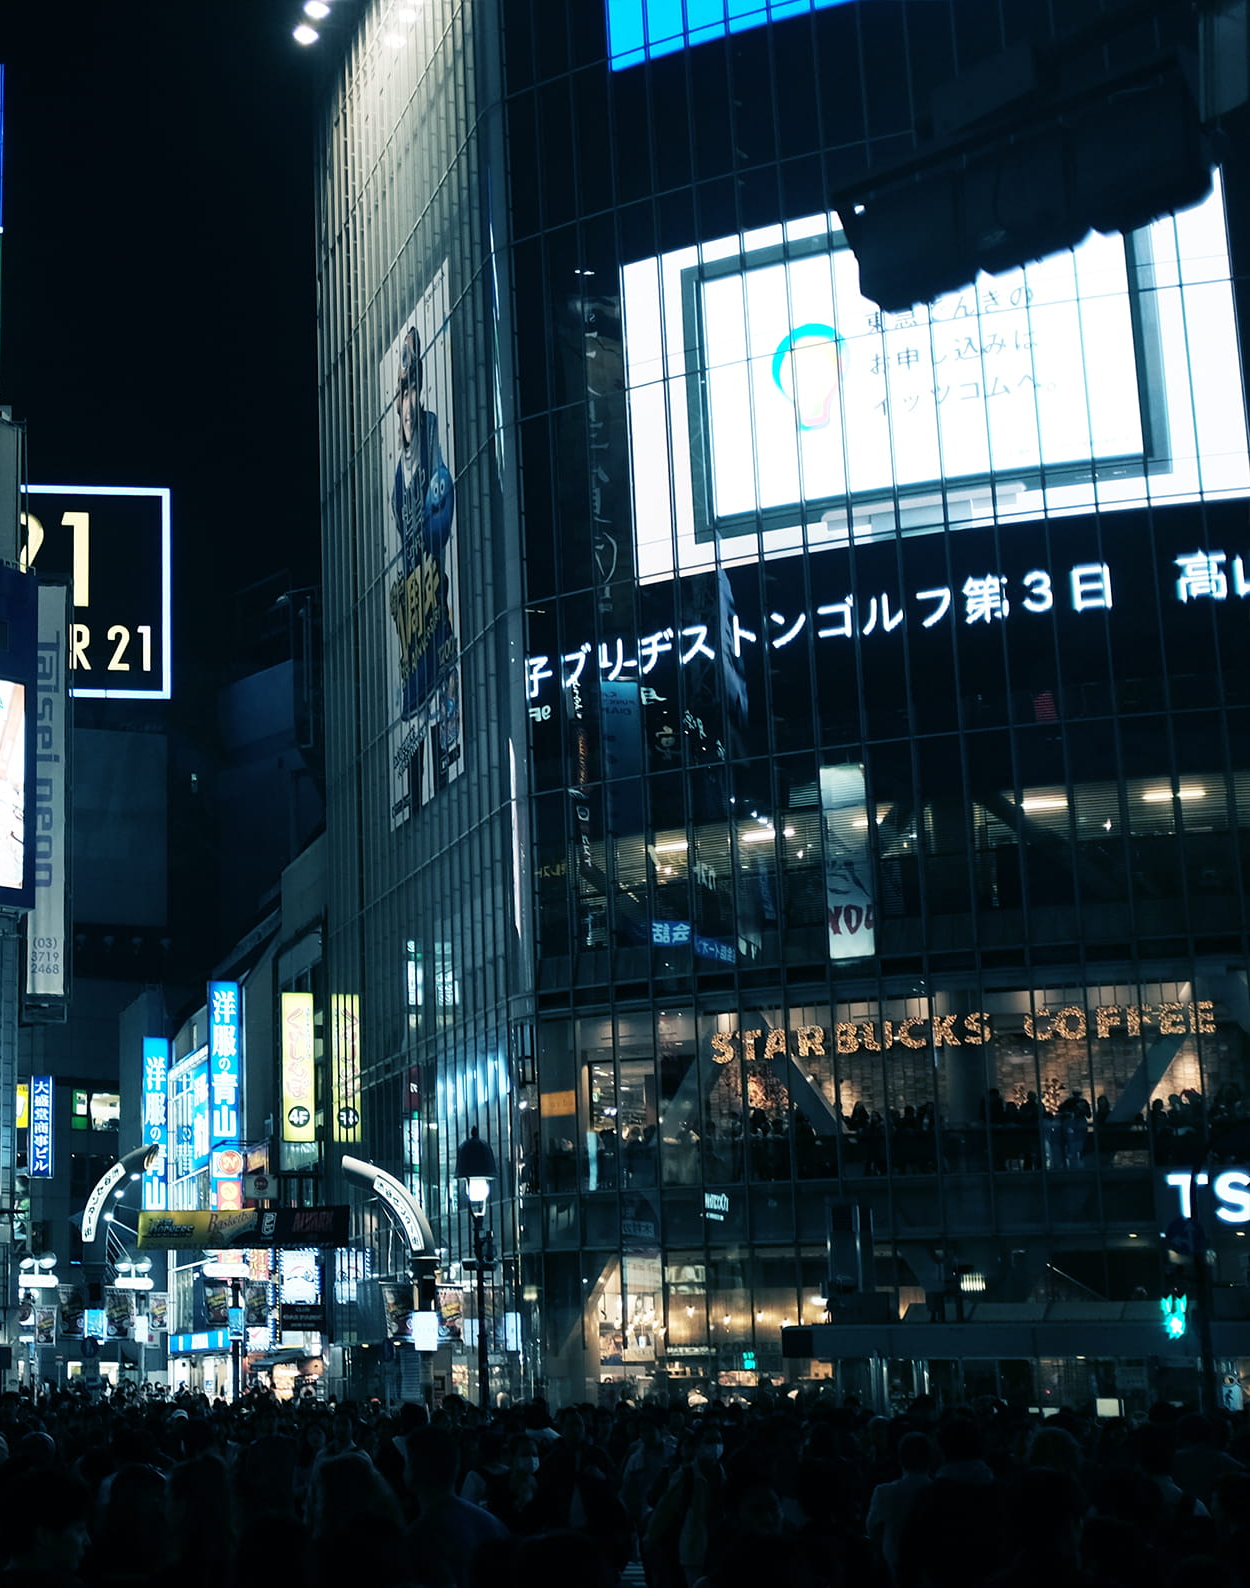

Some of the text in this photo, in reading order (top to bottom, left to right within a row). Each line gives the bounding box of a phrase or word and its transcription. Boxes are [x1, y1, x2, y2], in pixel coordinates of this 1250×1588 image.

[871, 330, 1038, 375] お申し込みは
[107, 624, 152, 672] 21
[31, 950, 60, 963] 3719
[32, 936, 58, 950] (03)
[31, 962, 60, 975] 2468
[710, 999, 1218, 1065] STARBUCKS COFFEE
[212, 989, 238, 1138] 洋服の青山
[34, 1081, 50, 1172] 大盛堂商事ビル
[144, 1055, 168, 1210] 洋服の青山
[288, 1108, 309, 1125] 4F
